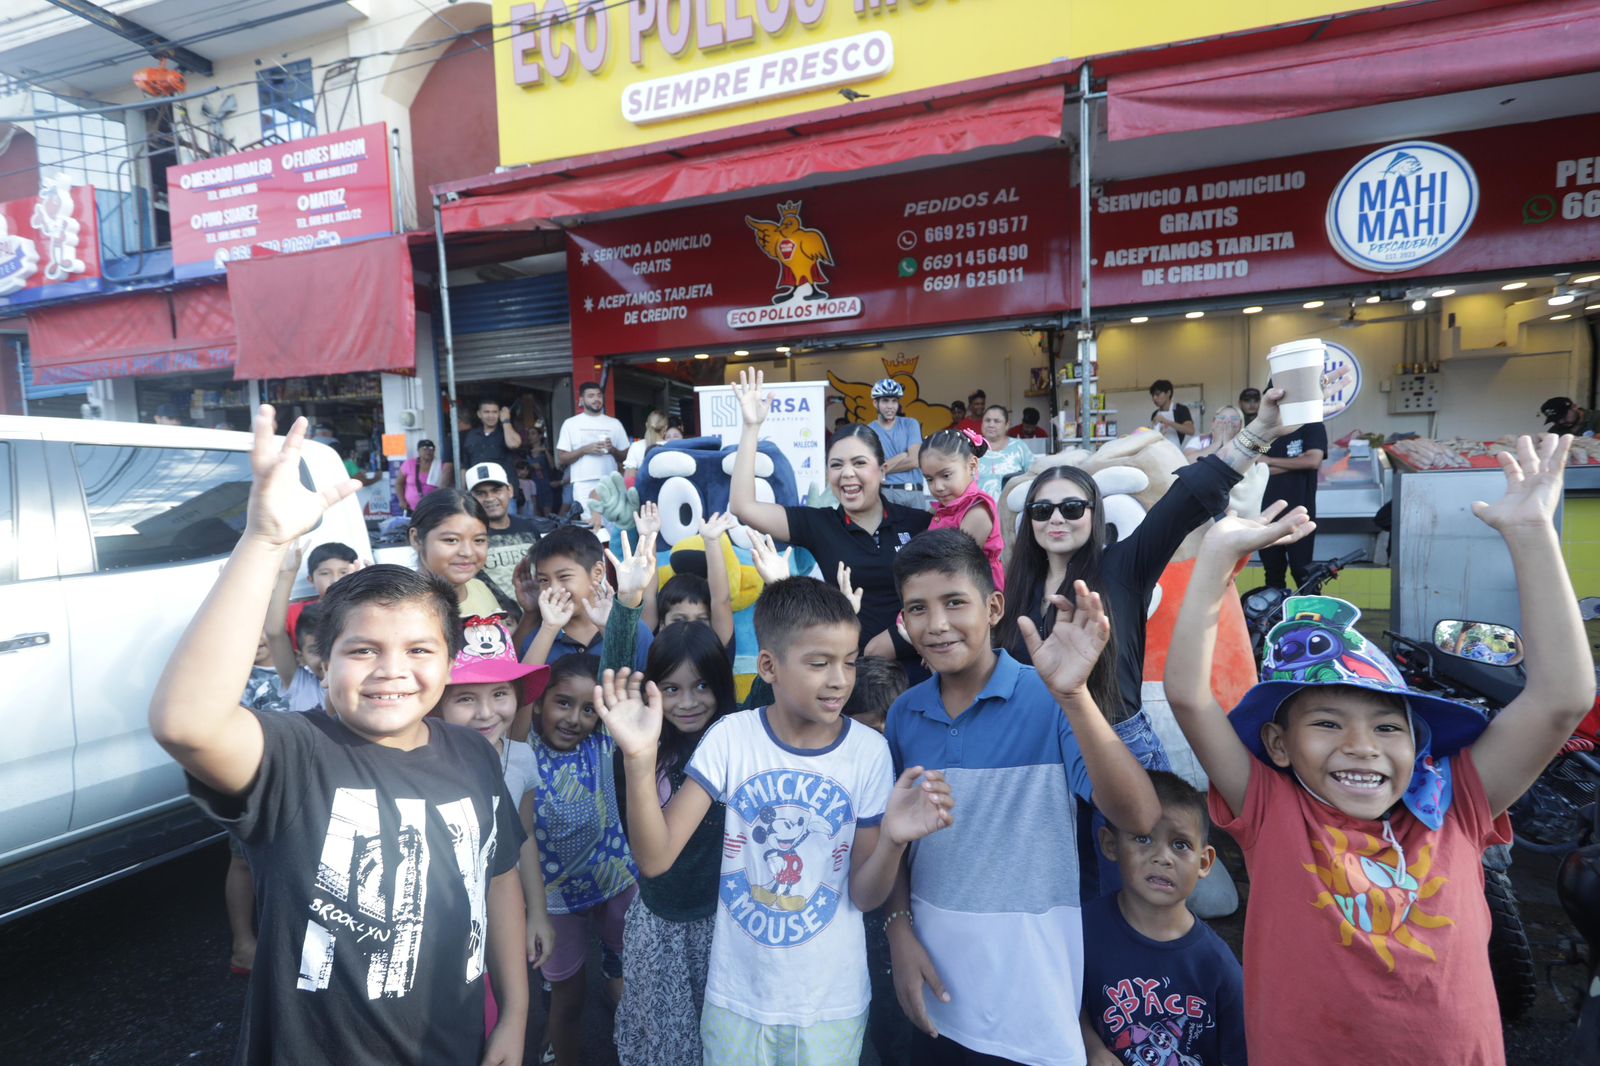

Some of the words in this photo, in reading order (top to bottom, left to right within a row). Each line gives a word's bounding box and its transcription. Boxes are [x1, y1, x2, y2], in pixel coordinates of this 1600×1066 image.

[510, 0, 607, 85] ECO
[628, 66, 750, 116] SIEMPRE
[759, 37, 886, 91] FRESCO
[904, 192, 989, 217] PEDIDOS
[993, 187, 1020, 204] AL
[1098, 187, 1182, 214] SERVICIO
[1185, 185, 1198, 203] A
[1202, 170, 1306, 201] DOMICILIO
[1359, 171, 1448, 212] MAHI
[1160, 206, 1239, 234] GRATIS
[1358, 203, 1447, 243] MAHI
[593, 243, 641, 263] SERVICIO
[643, 241, 652, 255] A
[654, 233, 711, 253] DOMICILIO
[1103, 239, 1213, 268] ACEPTAMOS
[1216, 231, 1295, 255] TARJETA
[633, 258, 671, 276] GRATIS
[1142, 269, 1164, 287] DE
[1168, 260, 1249, 283] CREDITO
[597, 289, 662, 310] ACEPTAMOS
[664, 283, 713, 301] TARJETA
[624, 311, 638, 325] DE
[641, 306, 687, 323] CREDITO
[730, 311, 756, 325] ECO
[759, 304, 812, 322] POLLOS
[816, 299, 857, 315] MORA
[762, 397, 811, 413] RSA
[484, 548, 528, 570] GUE
[744, 773, 847, 817] MICKEY
[308, 898, 391, 943] BROOKLYN
[730, 891, 823, 944] MOUSE
[1106, 977, 1160, 1007] MY
[1103, 991, 1207, 1033] SPACE
